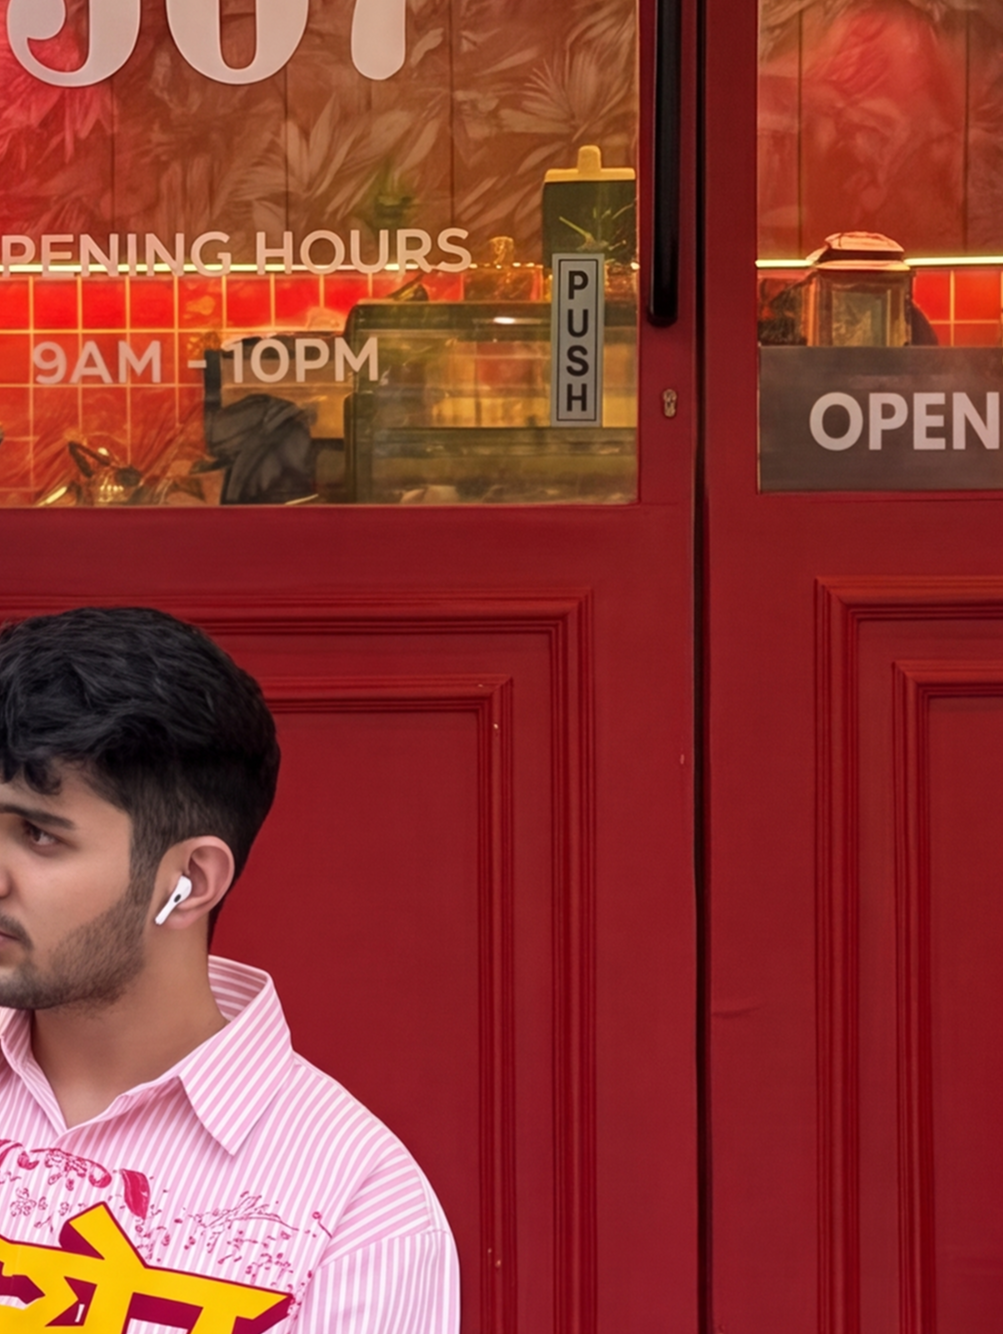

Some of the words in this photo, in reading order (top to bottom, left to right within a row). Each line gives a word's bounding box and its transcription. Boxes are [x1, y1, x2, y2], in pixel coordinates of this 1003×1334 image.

[256, 228, 472, 275] HOURS
[32, 339, 161, 384] 9AM
[223, 337, 379, 384] 10PM
[566, 270, 589, 412] PUSH
[809, 391, 1000, 451] OPEN
